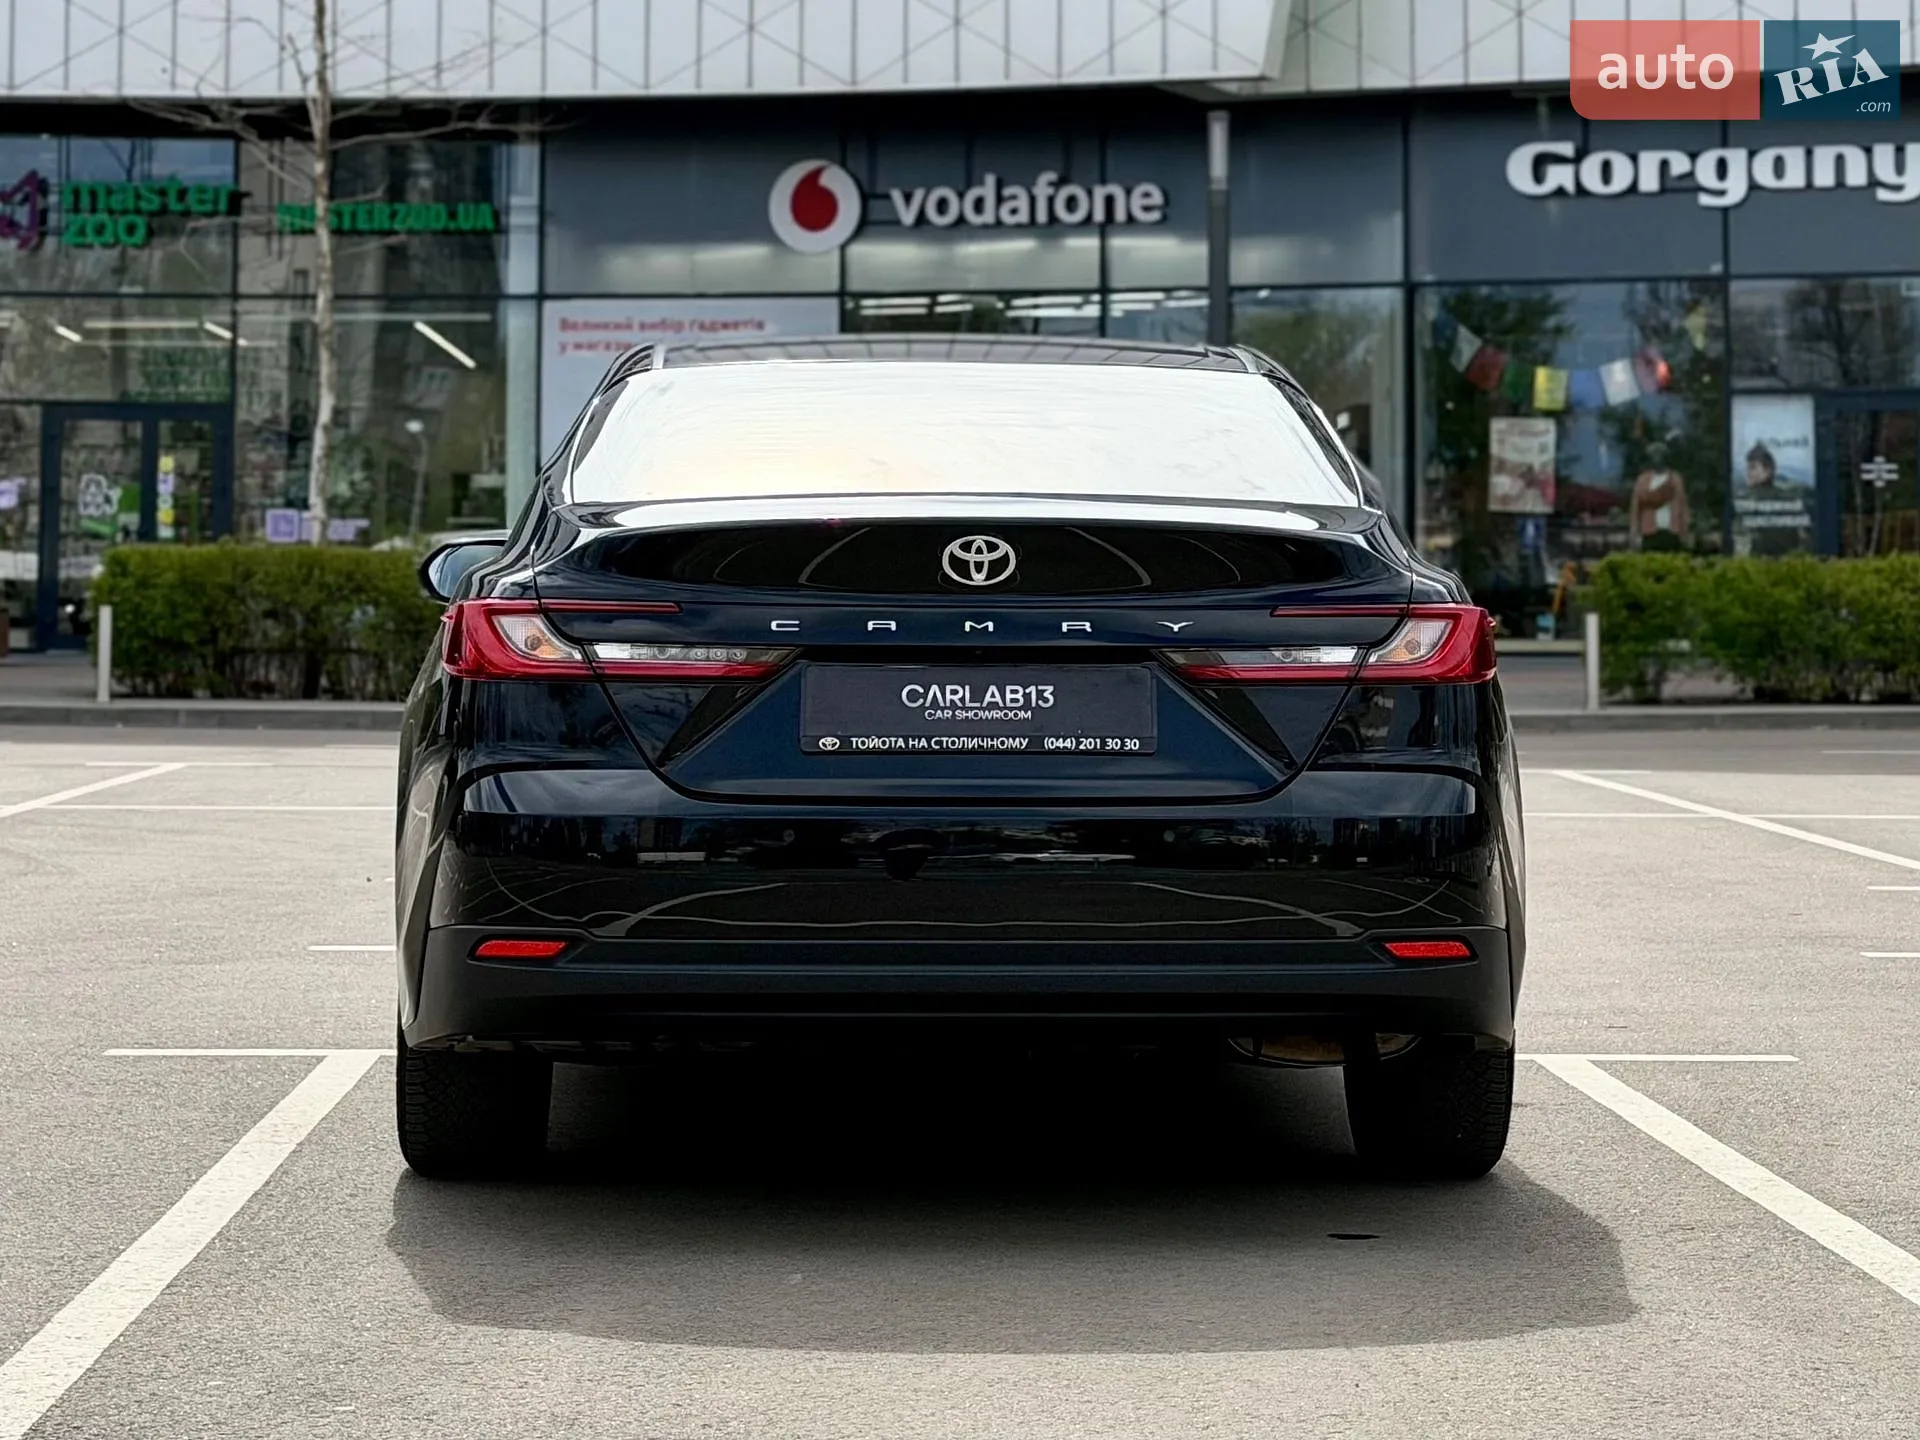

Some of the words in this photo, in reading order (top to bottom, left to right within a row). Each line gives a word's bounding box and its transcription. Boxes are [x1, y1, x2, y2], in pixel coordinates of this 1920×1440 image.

[1506, 140, 1920, 208] Gorgany
[62, 175, 238, 214] master
[890, 171, 1165, 228] vodafone
[62, 215, 149, 247] zoo
[559, 316, 633, 332] Великий
[770, 619, 1195, 634] CAMRY
[901, 684, 1055, 708] CARLAB13
[924, 709, 952, 721] CAR
[955, 709, 1032, 721] SHOWROOM
[850, 734, 905, 750] ТОЙОТА
[908, 736, 927, 750] НА
[930, 735, 1029, 751] СТОЛИЧНОМУ
[1043, 736, 1076, 751] (044)
[1079, 737, 1101, 751] 201
[1105, 738, 1121, 751] 30
[1123, 738, 1140, 751] 30
